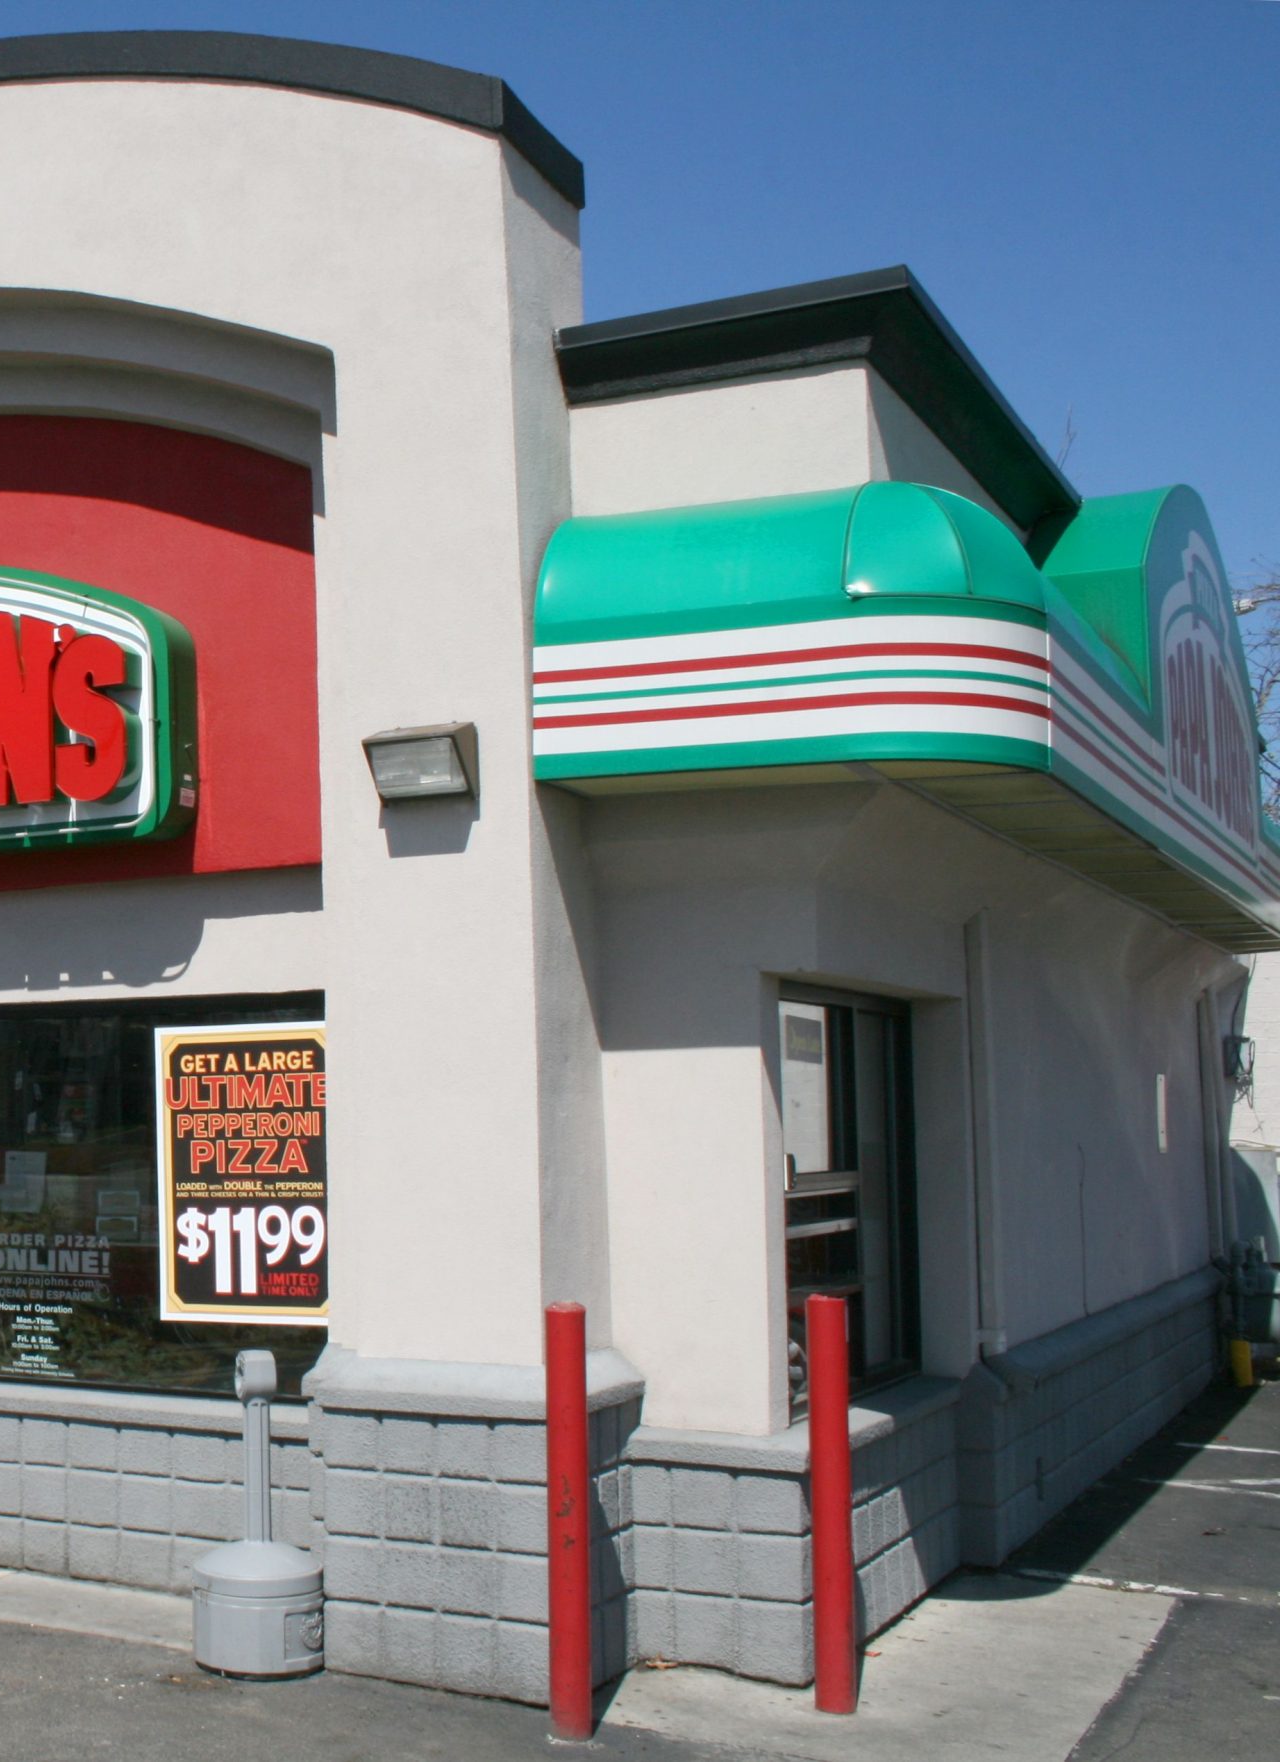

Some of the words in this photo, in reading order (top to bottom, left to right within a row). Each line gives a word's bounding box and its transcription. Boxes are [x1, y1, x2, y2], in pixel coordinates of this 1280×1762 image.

[180, 1054, 219, 1073] GET
[224, 1053, 239, 1072] A
[244, 1051, 314, 1071] LARGE
[165, 1072, 327, 1110] ULTIMATE
[177, 1111, 320, 1138] PEPPERONI
[190, 1139, 308, 1174] PIZZA
[176, 1182, 207, 1191] LOADED
[223, 1181, 262, 1191] DOUBLE
[275, 1182, 323, 1191] PEPPERONI
[54, 1234, 111, 1248] PIZZA
[259, 1272, 320, 1287] LIMITED
[261, 1286, 287, 1296] TIME
[288, 1286, 320, 1297] ONLY
[23, 1303, 32, 1311] of
[34, 1304, 73, 1314] Operation
[20, 1353, 48, 1362] Sunday
